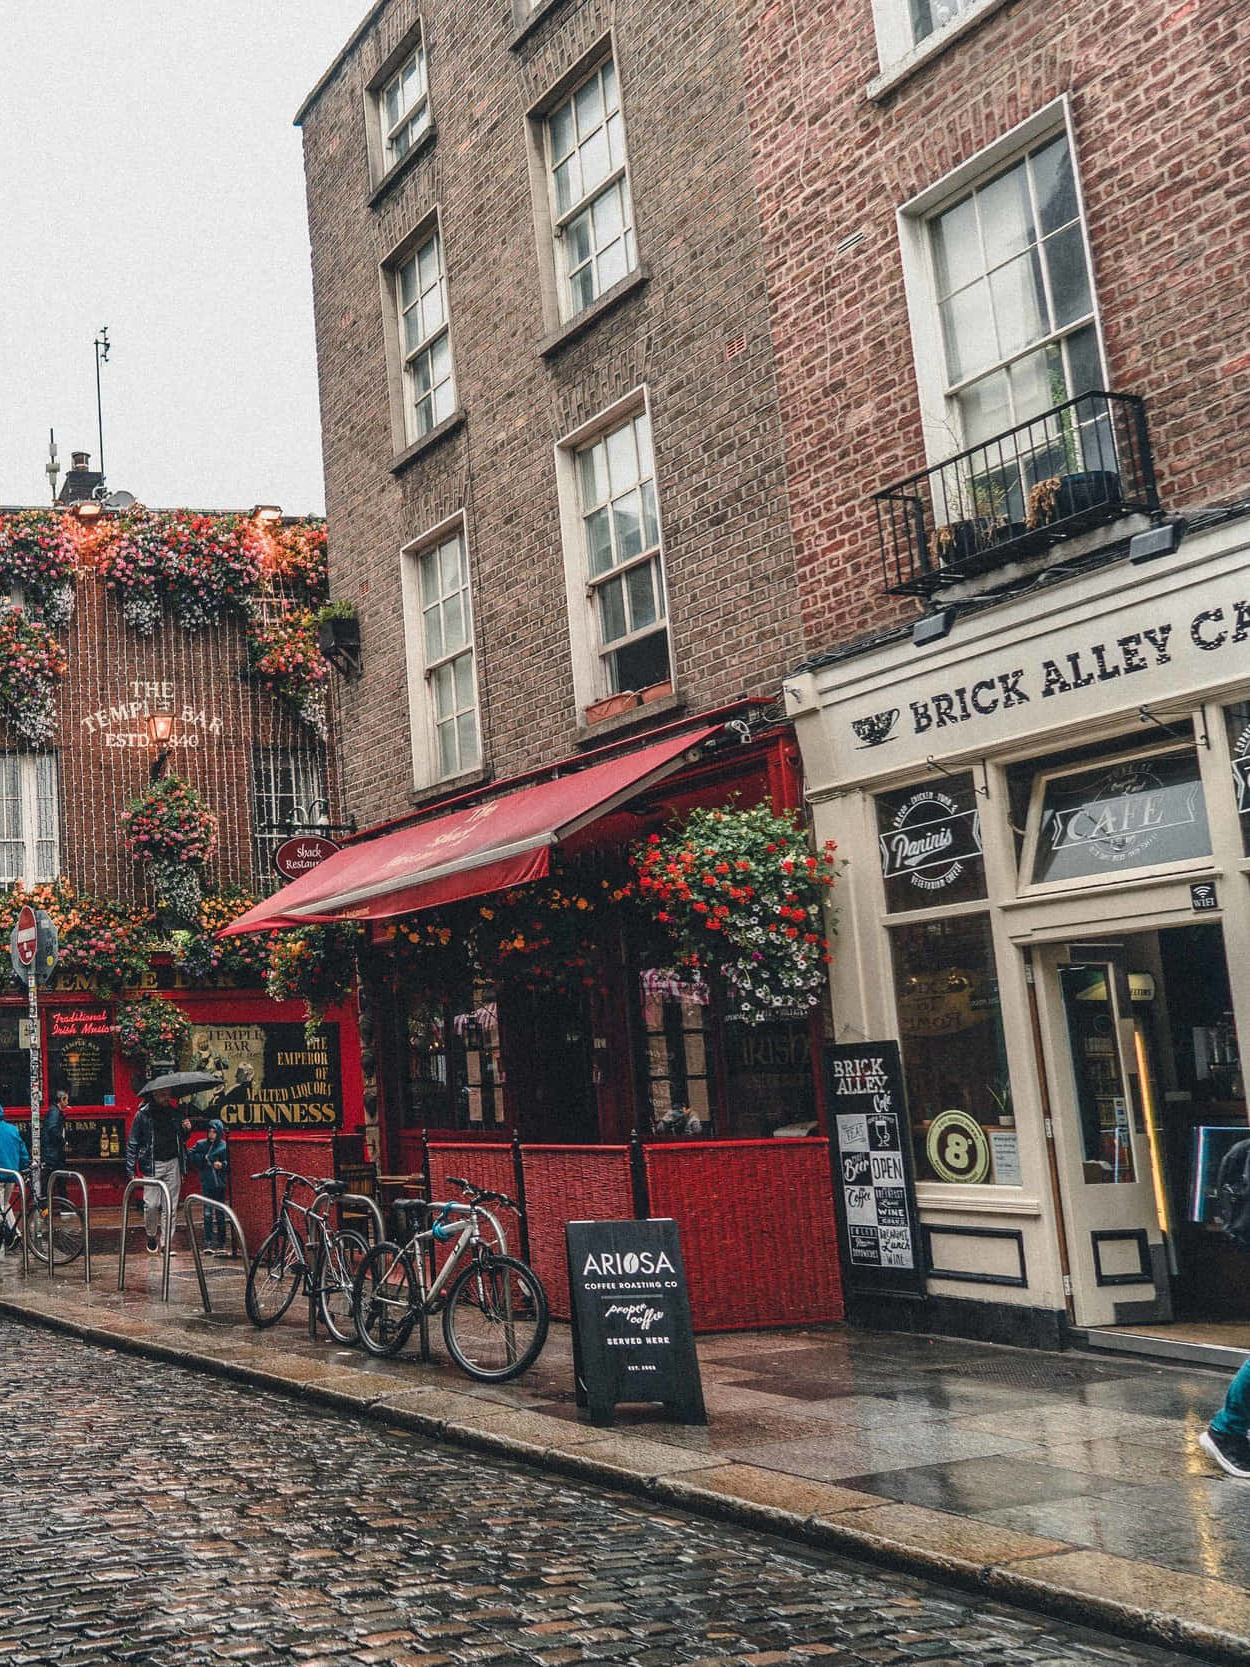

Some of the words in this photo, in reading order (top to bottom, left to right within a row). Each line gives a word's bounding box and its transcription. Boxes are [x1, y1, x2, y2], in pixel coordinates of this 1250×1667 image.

[910, 669, 1030, 734] BRICK
[1041, 623, 1172, 697] ALLEY
[130, 682, 174, 698] THE
[181, 705, 223, 735] BAR
[165, 734, 199, 748] 840
[297, 843, 322, 859] Shack
[891, 827, 952, 868] Paninis
[52, 1010, 107, 1023] Traditional
[52, 1023, 76, 1035] Irish
[81, 1023, 110, 1034] Music
[206, 1030, 264, 1041] TEMPLE
[224, 1041, 250, 1051] BAR
[277, 1052, 328, 1065] EMPEROR
[316, 1067, 328, 1080] OF
[833, 1058, 885, 1077] BRICK
[290, 1081, 333, 1099] LIQUORS
[836, 1075, 888, 1095] ALLEY
[220, 1103, 336, 1124] GUINNESS
[844, 1158, 869, 1182] Beer
[872, 1157, 902, 1180] OPEN
[845, 1187, 871, 1208] Coffee
[878, 1208, 905, 1217] WINE
[583, 1251, 675, 1276] ARIOSA
[887, 1253, 904, 1265] WINE
[584, 1282, 616, 1290] COFFEE
[618, 1281, 662, 1289] ROASTING
[605, 1303, 647, 1321] proper
[630, 1308, 664, 1330] coffee
[606, 1337, 642, 1346] SERVED
[645, 1336, 670, 1345] HERE
